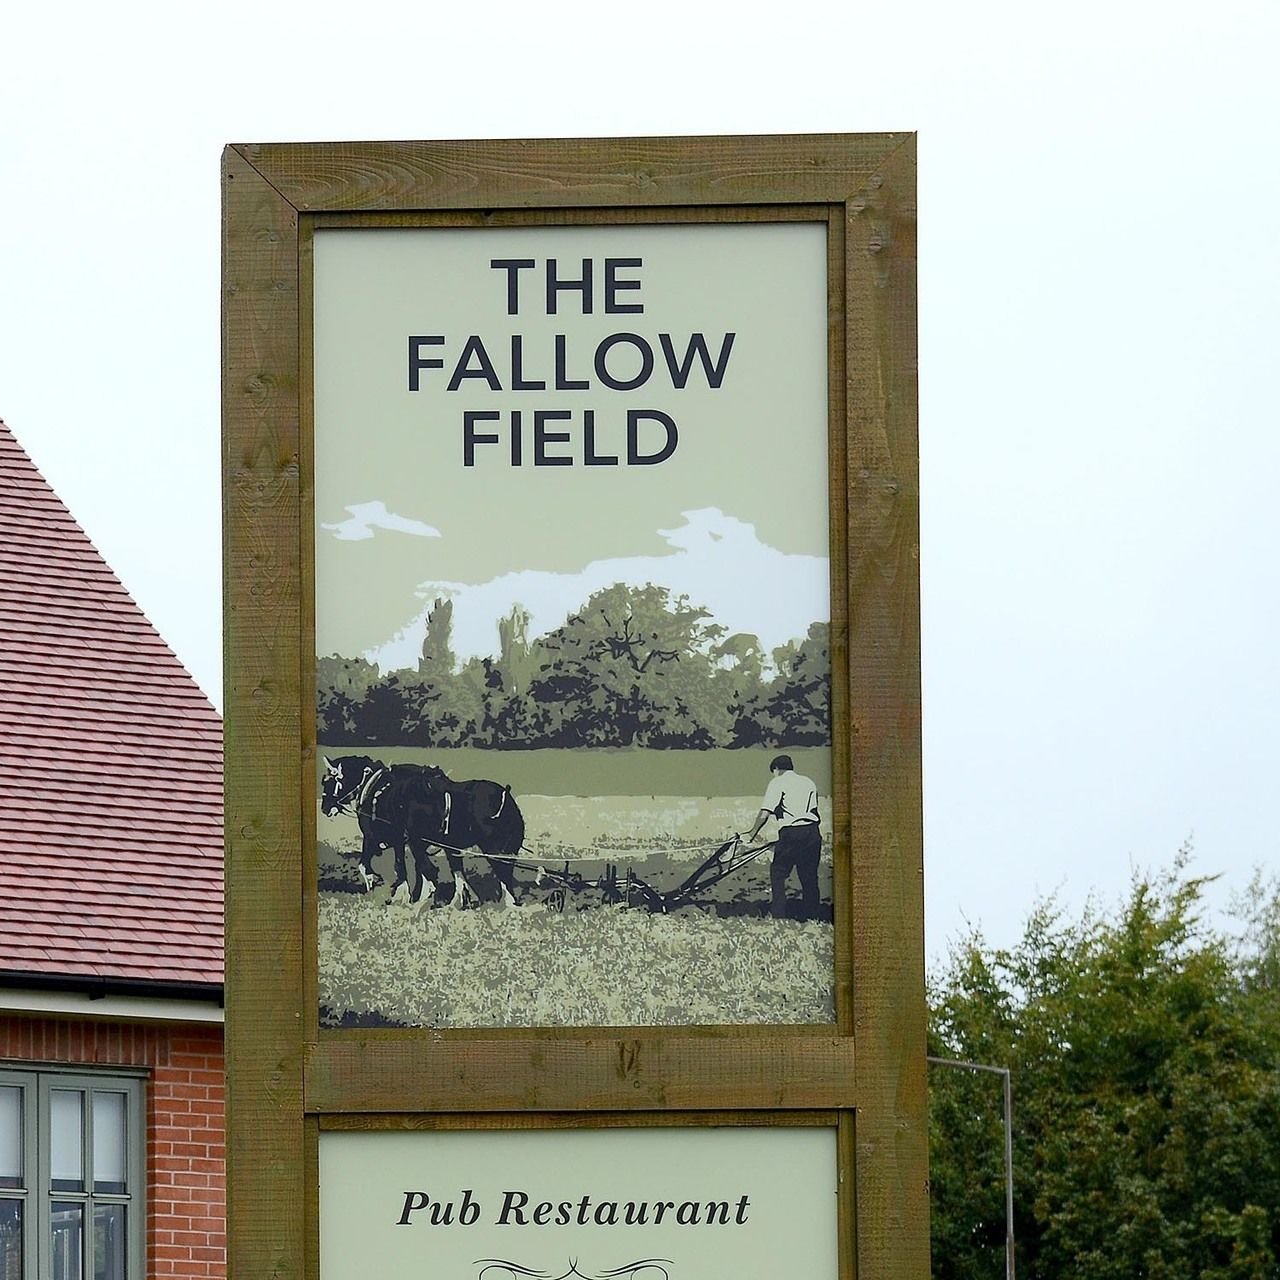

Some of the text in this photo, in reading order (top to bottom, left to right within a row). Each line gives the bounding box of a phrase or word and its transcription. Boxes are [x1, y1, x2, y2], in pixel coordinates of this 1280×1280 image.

[490, 257, 645, 316] THE
[407, 332, 736, 392] FALLOW
[462, 409, 679, 467] FIELD
[396, 1189, 751, 1226] Pub Restaurant
